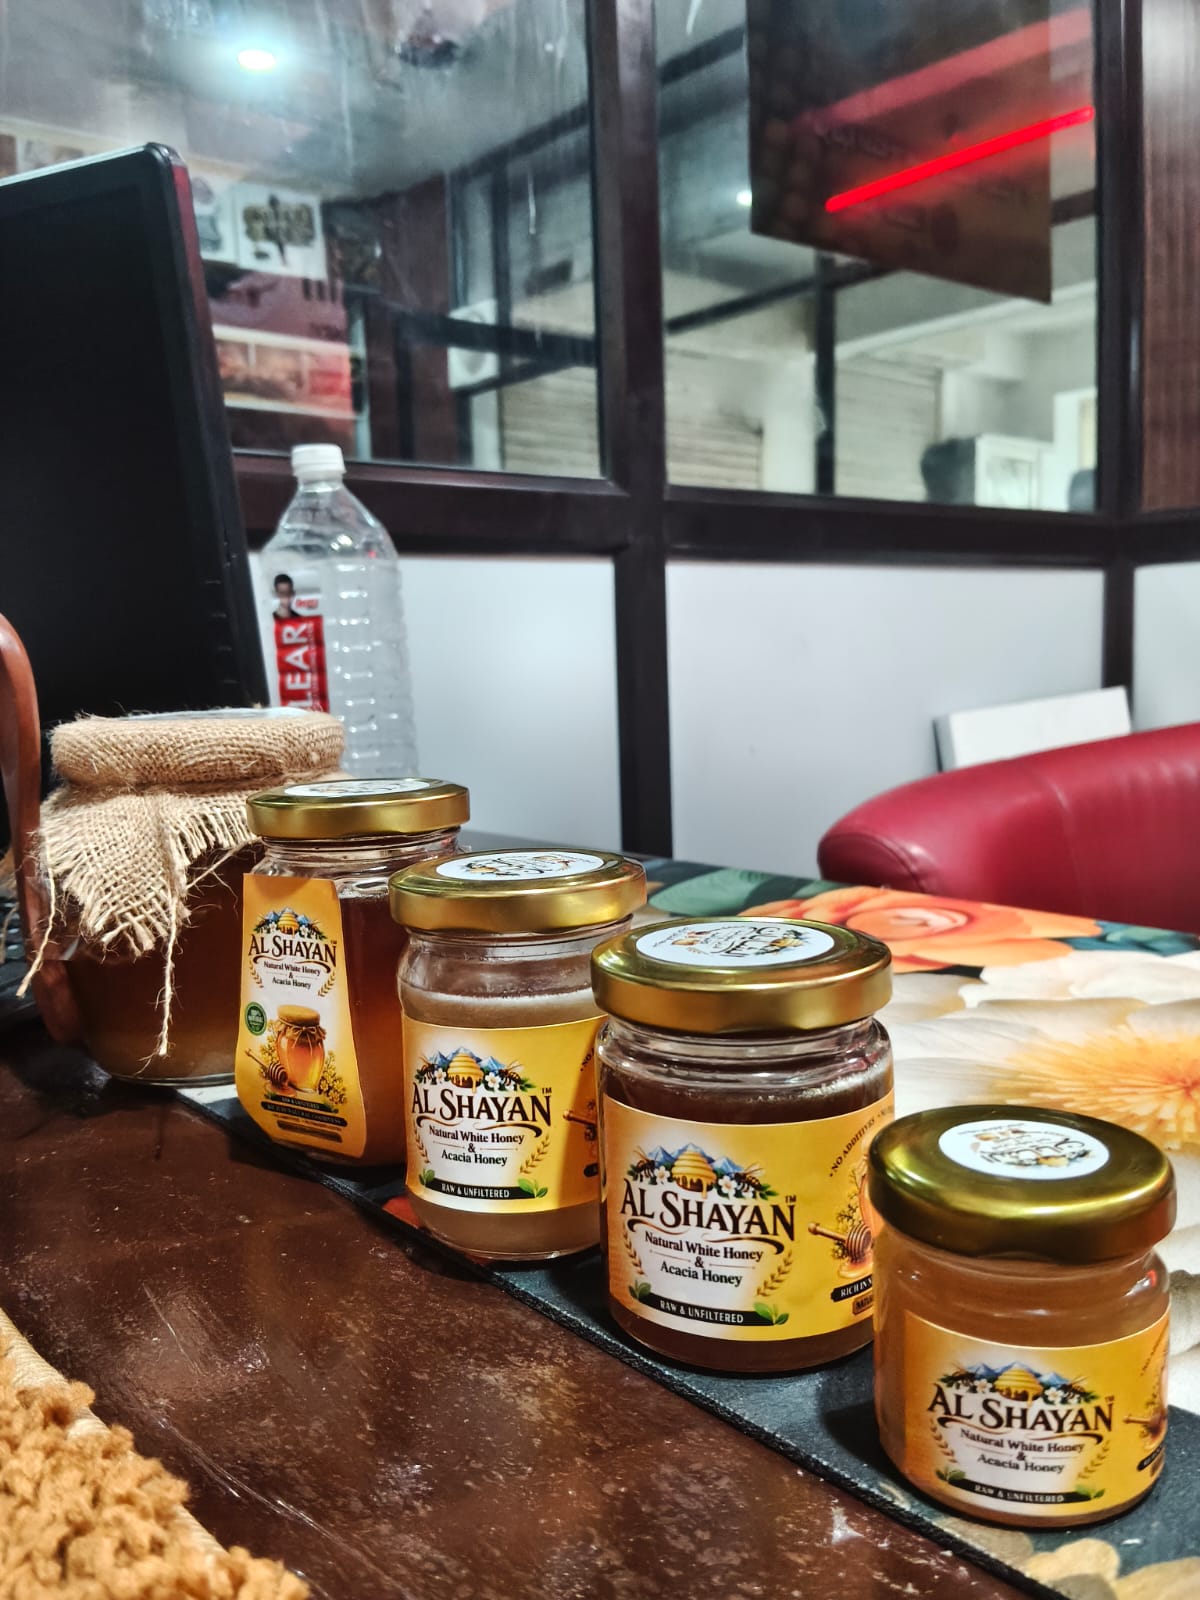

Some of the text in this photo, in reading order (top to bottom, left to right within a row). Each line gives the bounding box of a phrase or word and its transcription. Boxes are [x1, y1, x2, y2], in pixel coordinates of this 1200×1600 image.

[248, 934, 337, 967] AL SHAYAN
[264, 961, 321, 976] Natural White Honey
[288, 971, 294, 979] &
[272, 977, 311, 989] Acacia Honey
[412, 1082, 435, 1114] AL
[440, 1088, 551, 1127] SHAYAN
[429, 1125, 525, 1145] Natural White Honey
[467, 1143, 476, 1153] &
[441, 1150, 507, 1167] Acacia Honey
[441, 1183, 510, 1198] RAW & UNFILTERED
[620, 1178, 655, 1218] AL
[660, 1190, 795, 1241] SHAYAN
[645, 1231, 764, 1262] Natural White Honey
[694, 1256, 704, 1268] &
[660, 1261, 743, 1287] Acacia Honey
[840, 1283, 859, 1297] RICH
[660, 1300, 744, 1323] RAW & UNFILTERED
[928, 1383, 1114, 1433] AL SHAYAN
[960, 1428, 1085, 1454] Natural White Honey
[978, 1454, 1064, 1475] Acacia Honey
[1016, 1451, 1027, 1461] &
[974, 1484, 994, 1495] RAW
